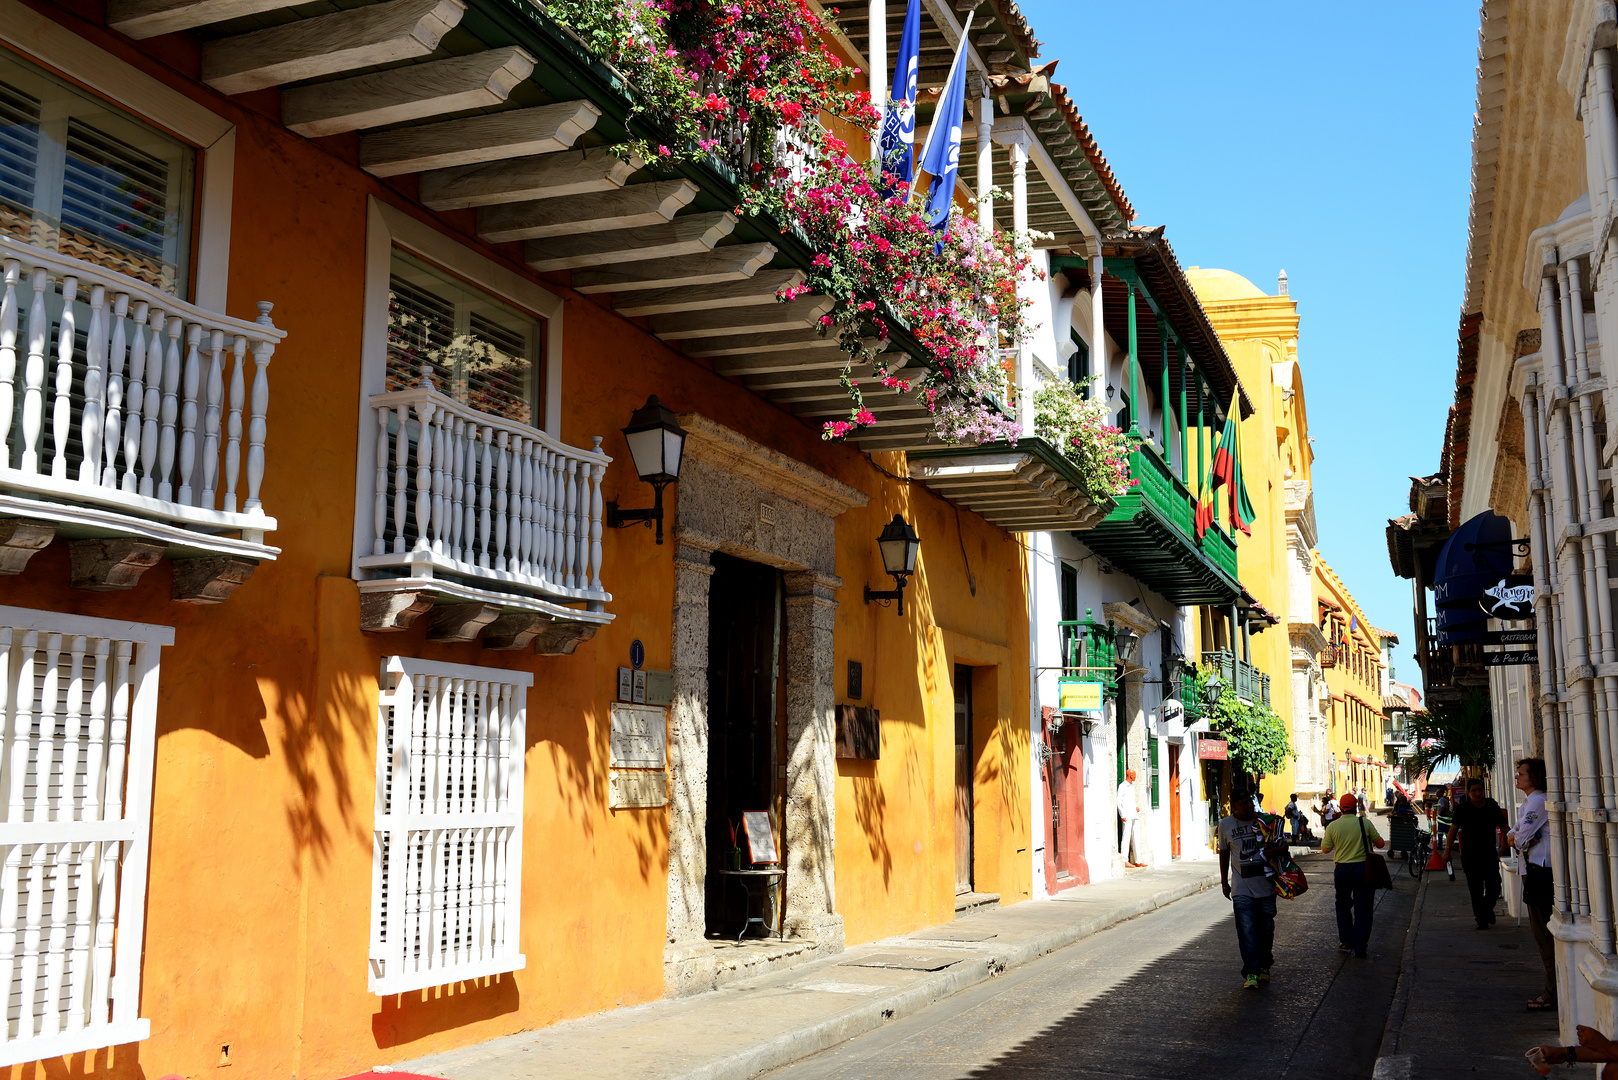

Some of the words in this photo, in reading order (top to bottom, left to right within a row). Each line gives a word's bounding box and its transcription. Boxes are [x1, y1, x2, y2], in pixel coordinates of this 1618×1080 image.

[1501, 634, 1536, 643] GASTROBAR
[1491, 654, 1500, 663] de
[1502, 653, 1519, 663] Paco
[1231, 826, 1248, 837] JUST
